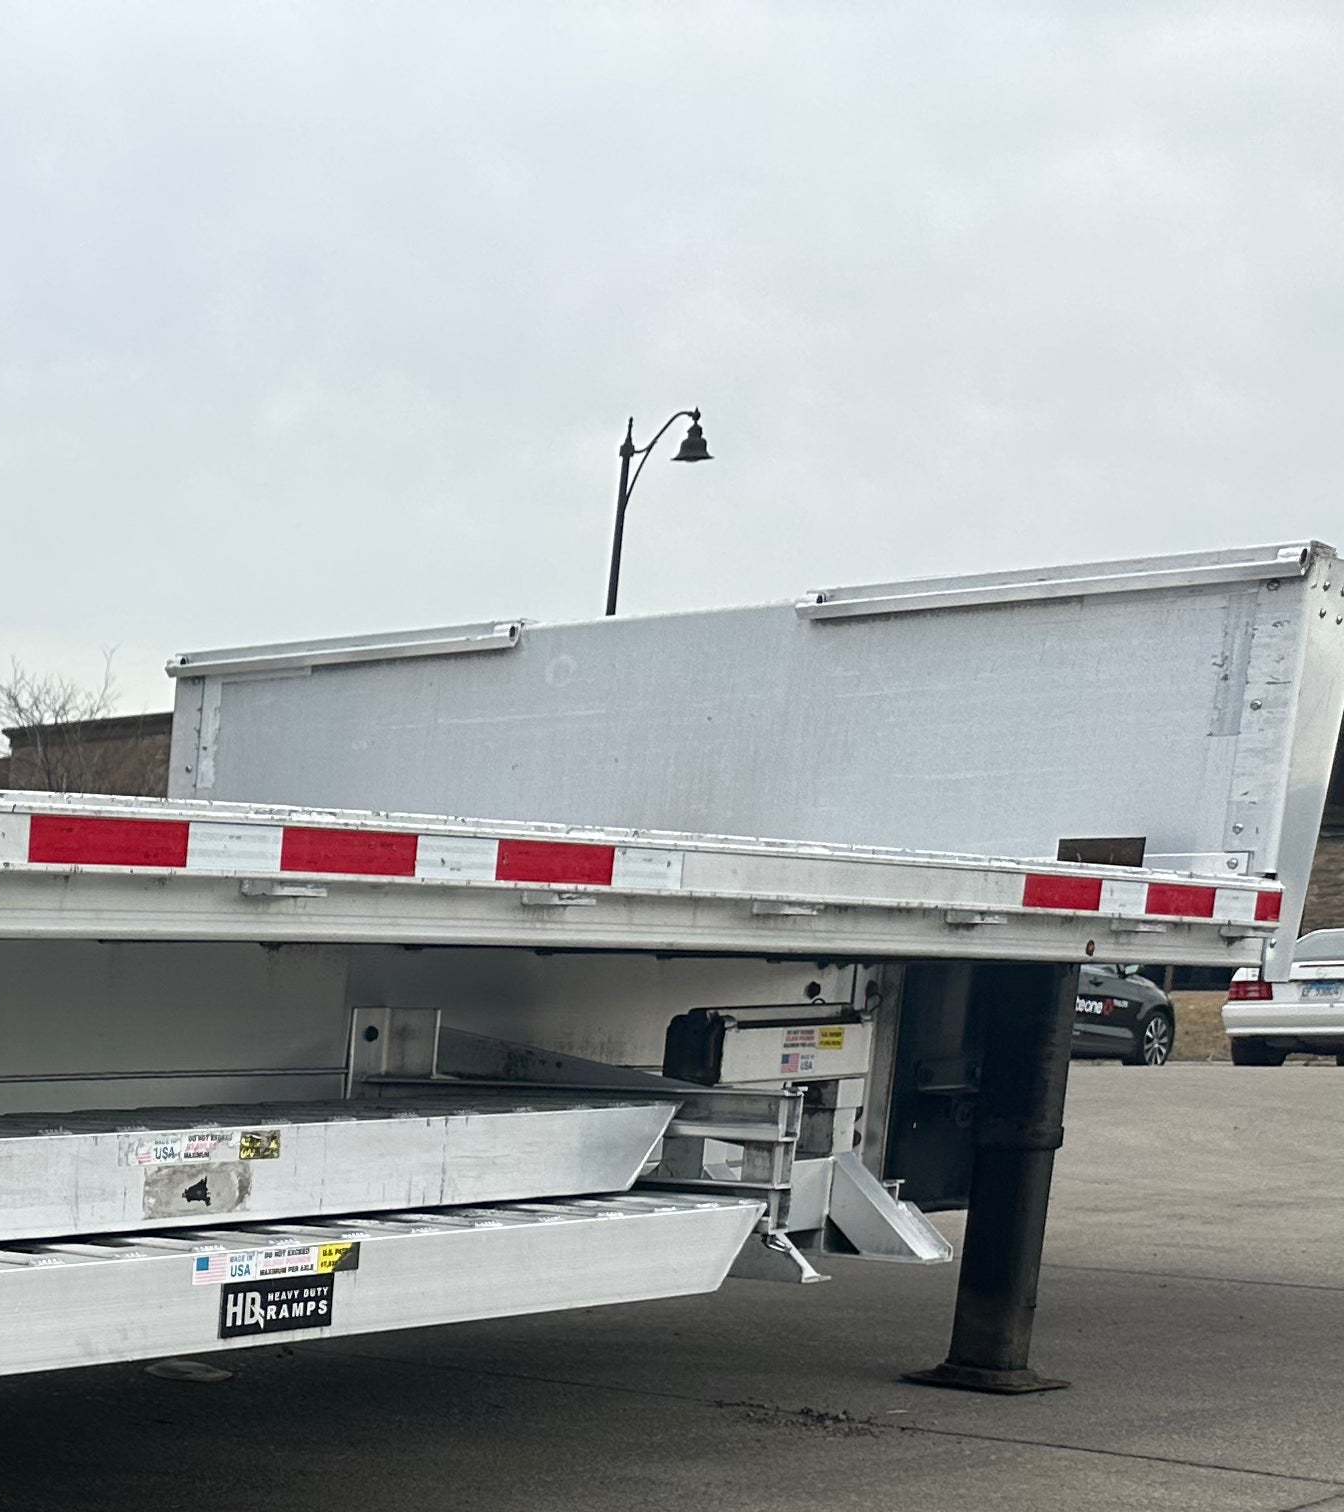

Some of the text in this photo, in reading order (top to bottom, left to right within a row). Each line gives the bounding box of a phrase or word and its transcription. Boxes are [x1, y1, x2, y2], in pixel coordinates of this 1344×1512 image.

[155, 1147, 175, 1160] USA
[229, 1253, 254, 1262] MADE IN
[264, 1247, 310, 1259] DO NOT EXCEED
[230, 1264, 251, 1277] USA
[259, 1266, 287, 1276] MAXIMUM
[288, 1265, 299, 1273] PER
[300, 1264, 314, 1272] AXLE
[267, 1286, 329, 1302] HEAVY DUTY
[266, 1300, 328, 1321] RAMPS
